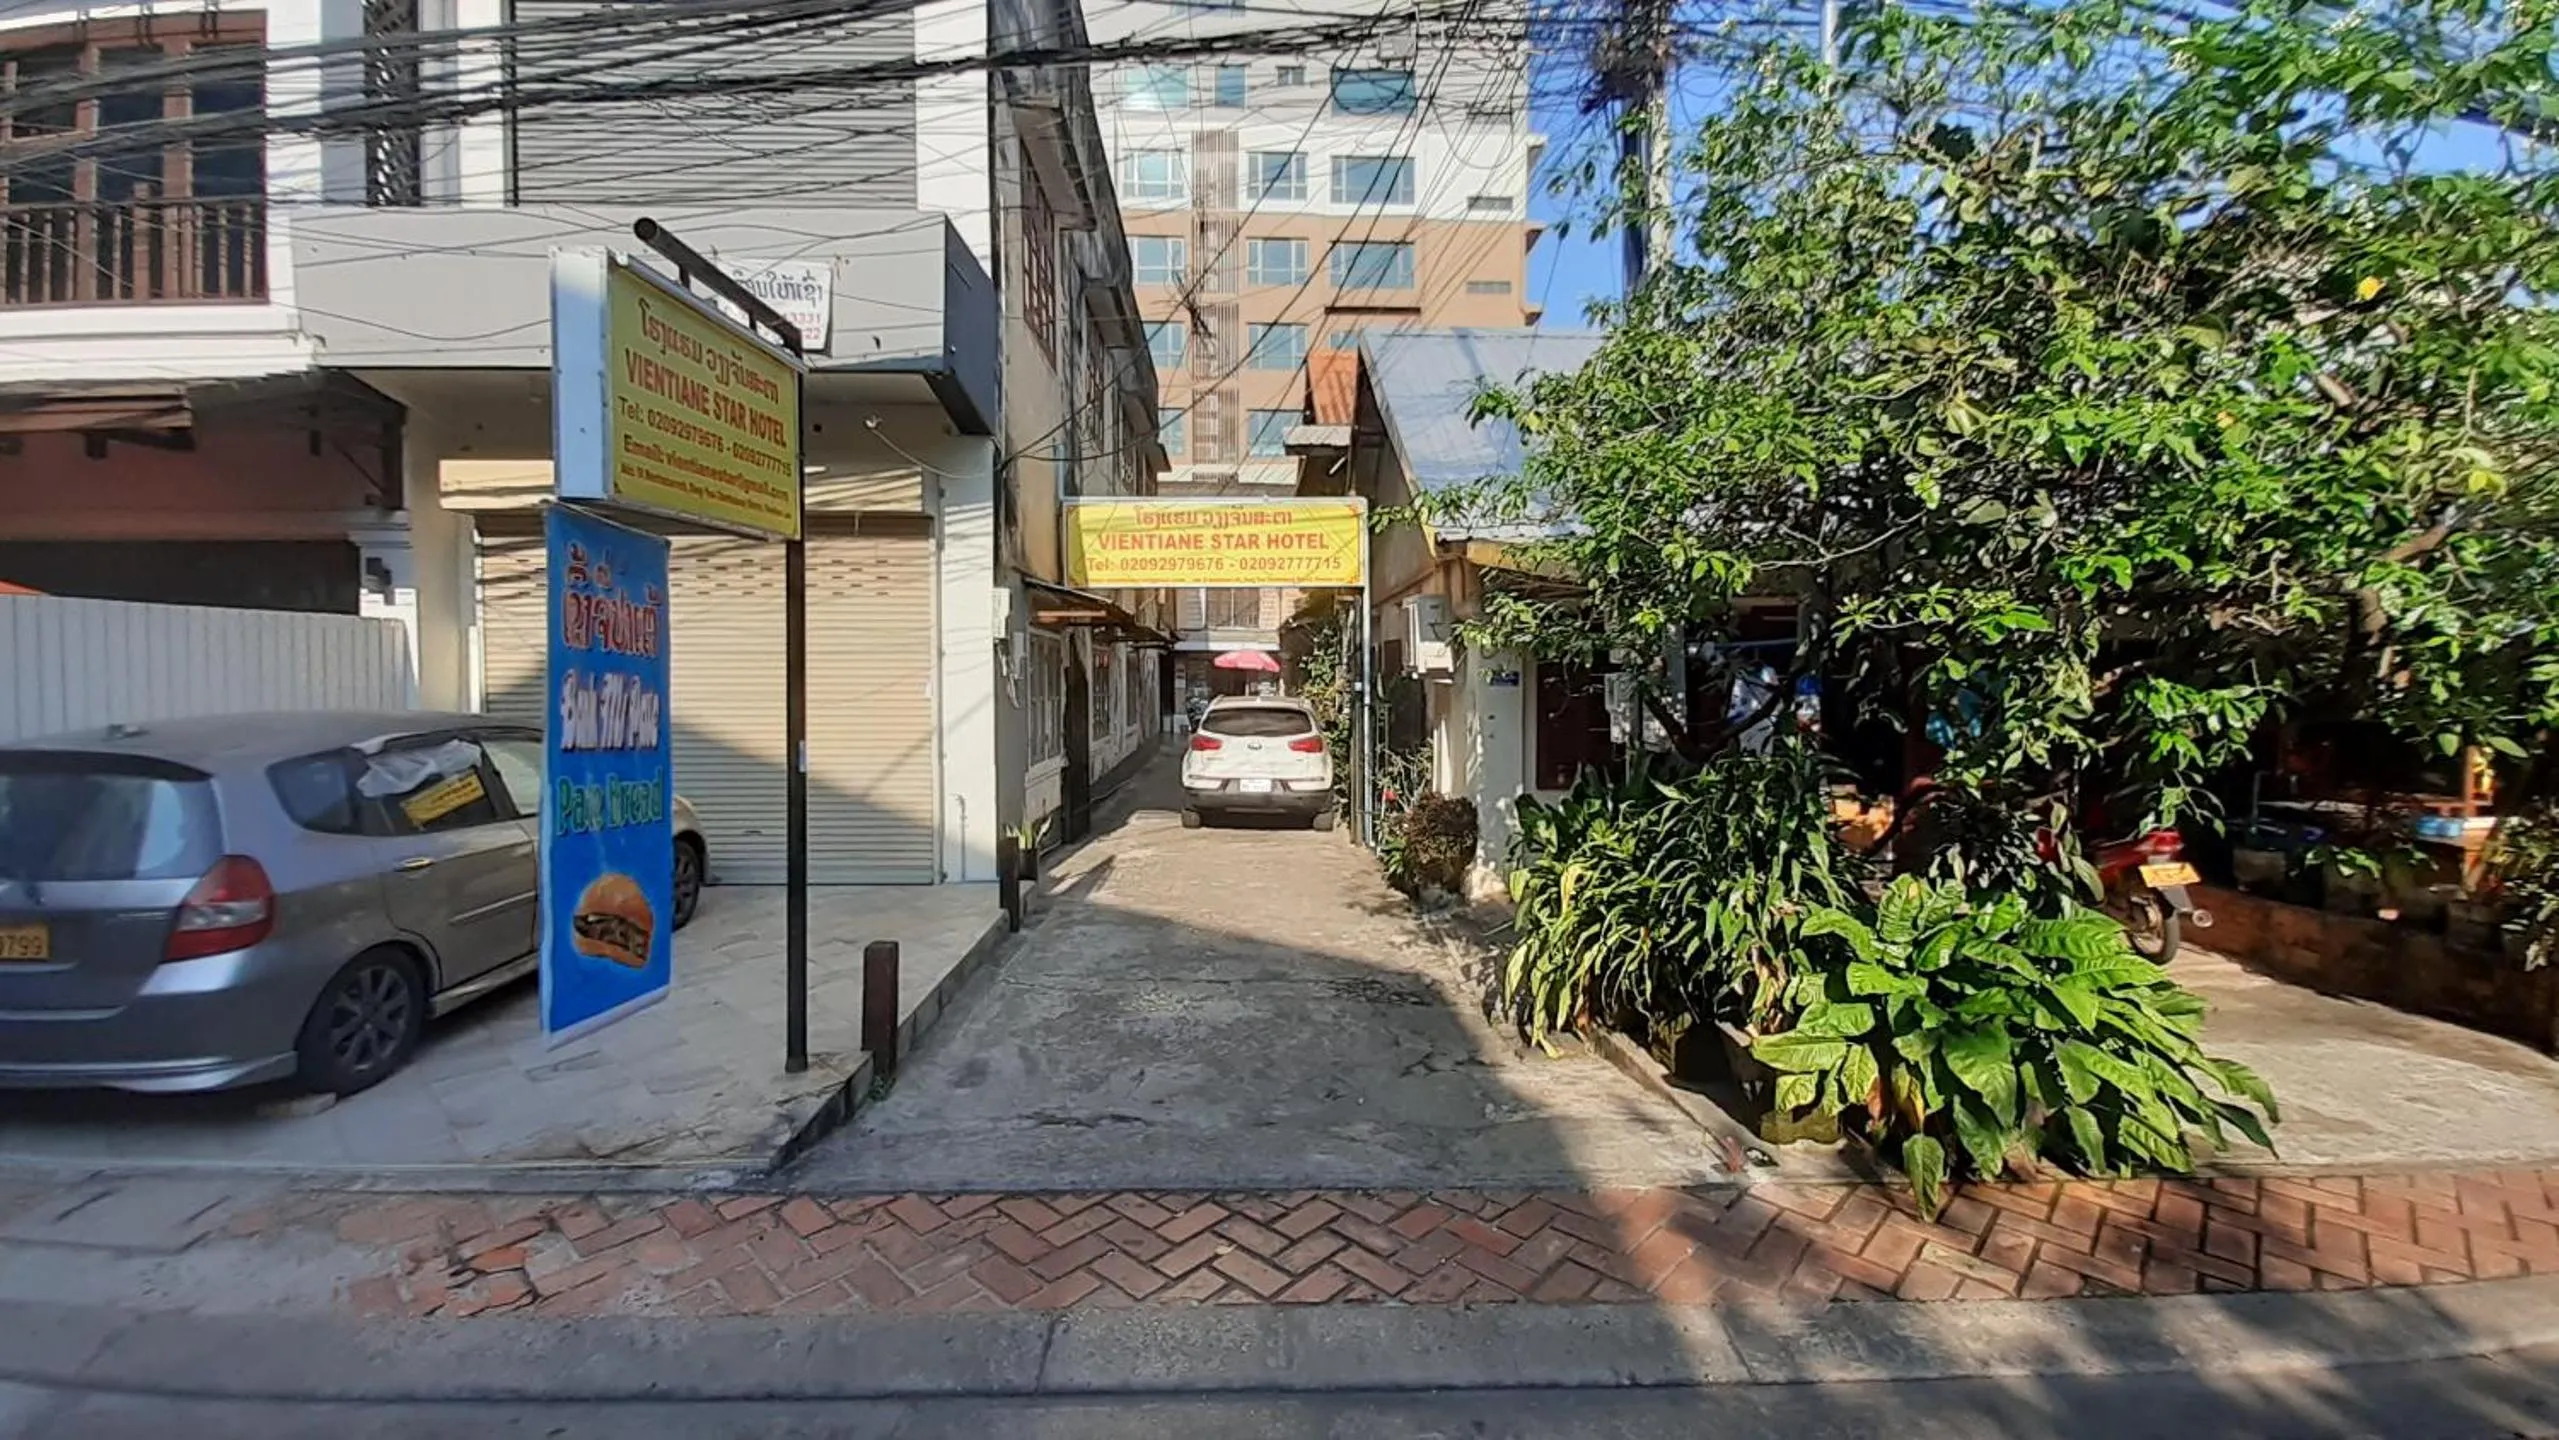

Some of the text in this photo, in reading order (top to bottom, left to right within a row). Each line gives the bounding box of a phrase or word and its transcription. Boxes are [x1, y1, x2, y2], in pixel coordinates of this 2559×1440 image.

[625, 347, 787, 447] VIENTIANE STAR HOTEL
[618, 395, 644, 423] Tel:
[1099, 533, 1330, 550] VIENTIANE STAR HOTEL
[1087, 557, 1115, 571] Tel:
[1120, 557, 1225, 571] 02092979676
[1240, 556, 1341, 571] 02092777715
